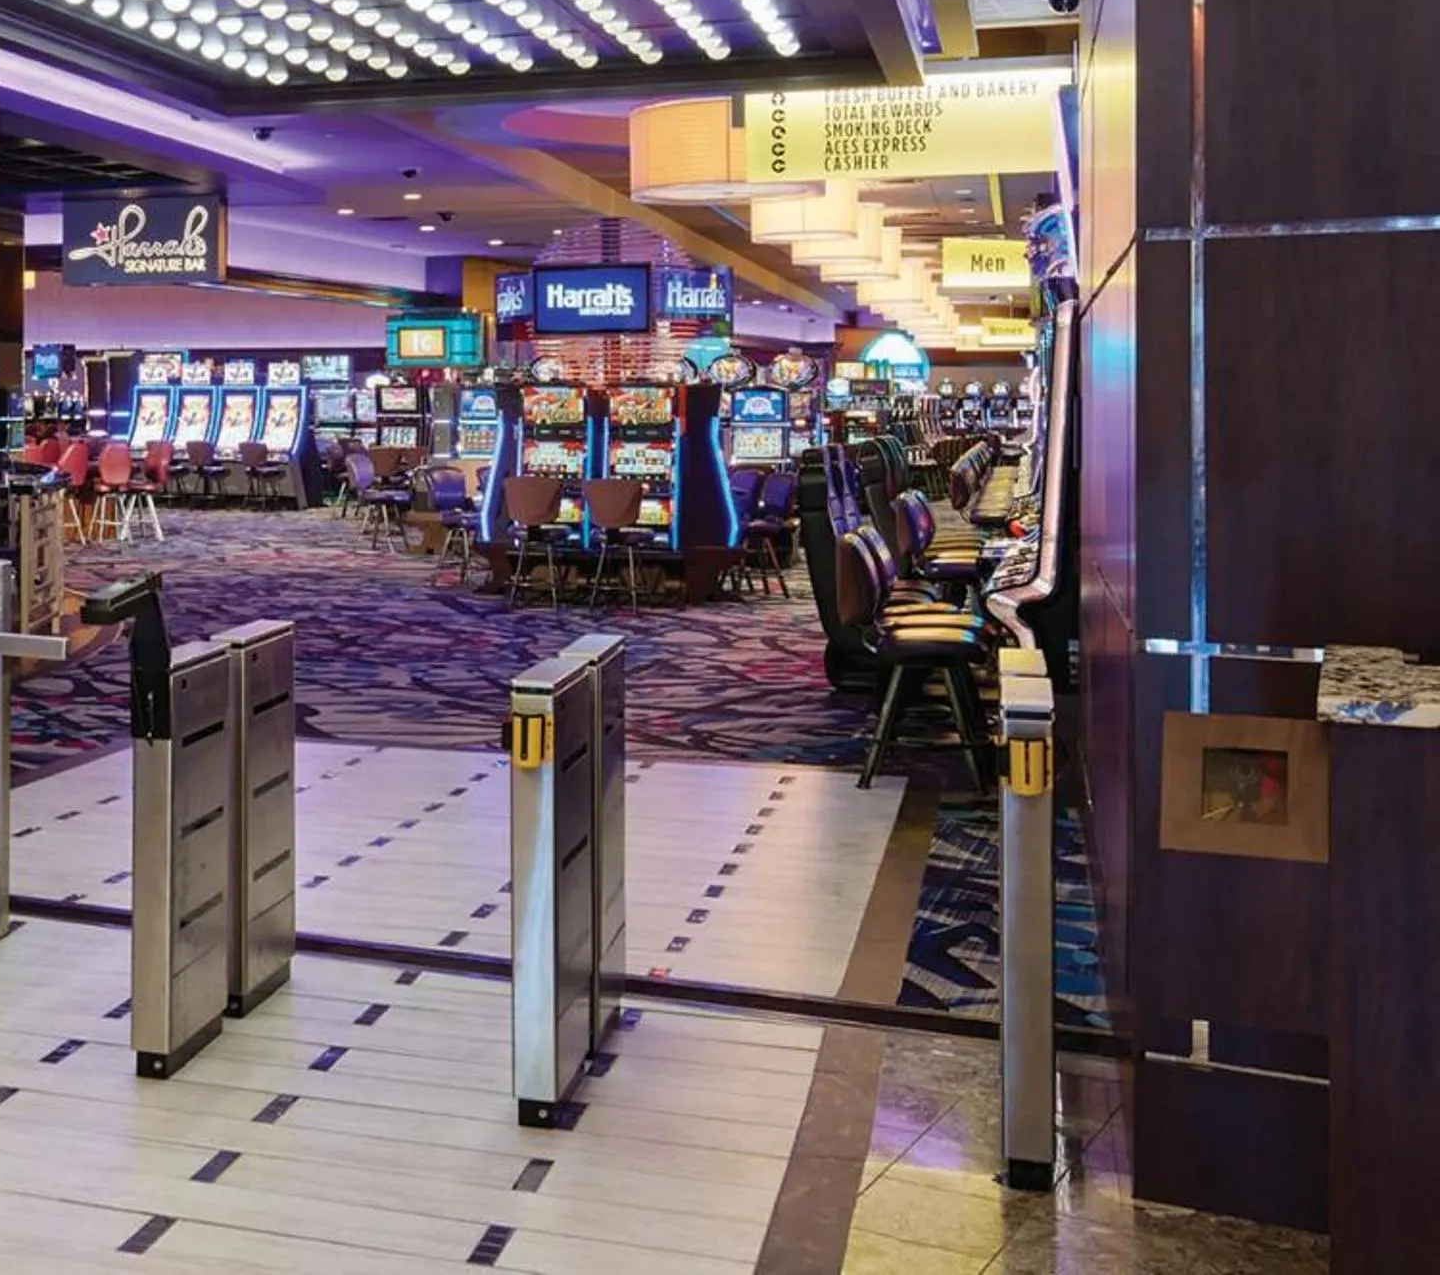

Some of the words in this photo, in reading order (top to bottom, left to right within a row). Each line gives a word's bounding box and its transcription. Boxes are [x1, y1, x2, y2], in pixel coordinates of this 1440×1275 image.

[939, 83, 971, 99] AND
[976, 78, 1038, 98] BAKERY
[825, 105, 865, 122] TOTAL
[871, 101, 942, 119] REWARDS
[824, 121, 890, 138] SMOKING
[895, 118, 932, 135] DECK
[825, 138, 859, 155] ACES
[863, 136, 926, 153] EXPRESS
[824, 155, 889, 172] CASHIER
[184, 257, 207, 272] BAR
[970, 253, 1005, 272] Men
